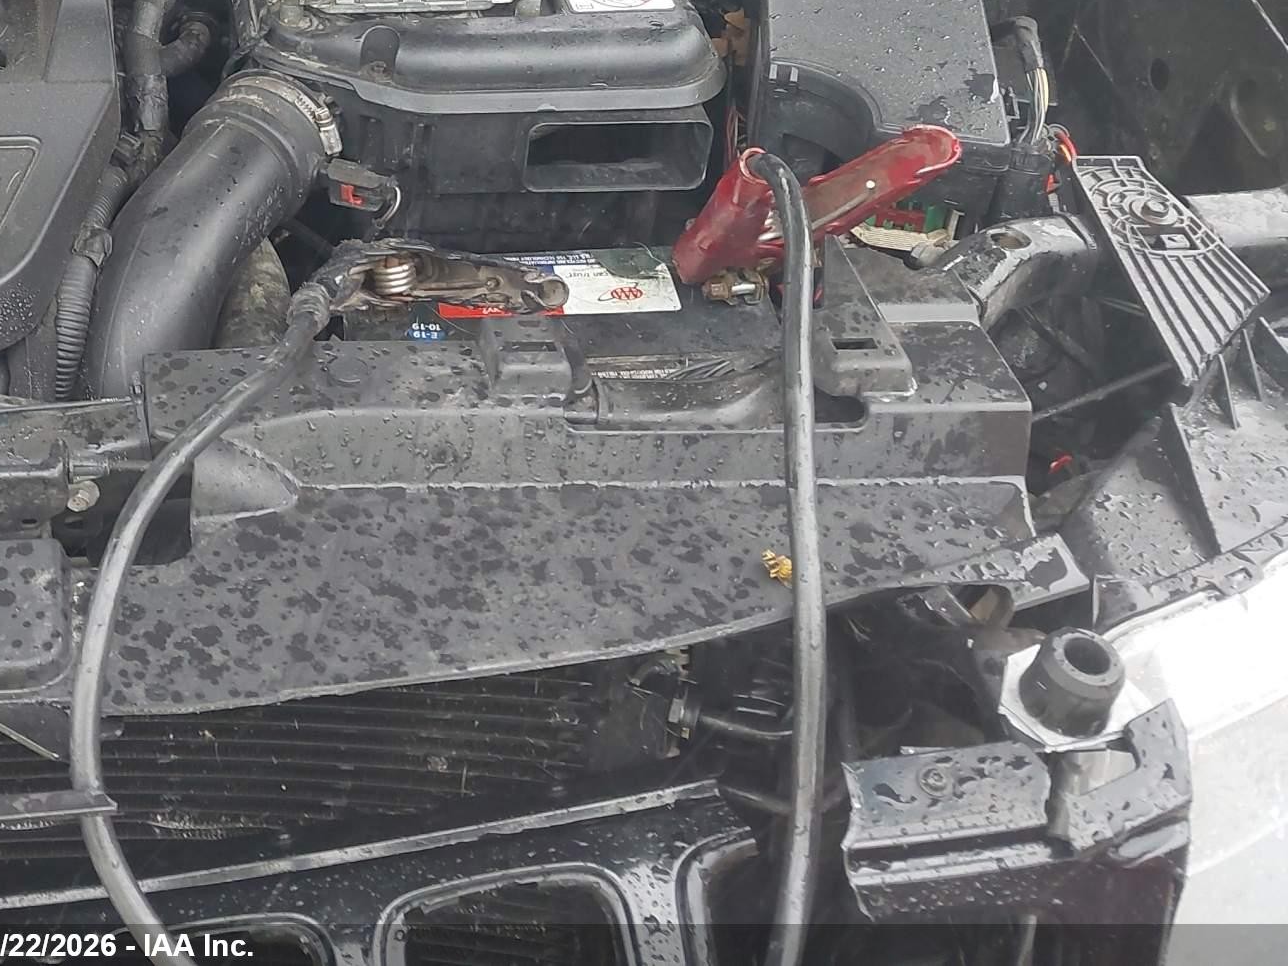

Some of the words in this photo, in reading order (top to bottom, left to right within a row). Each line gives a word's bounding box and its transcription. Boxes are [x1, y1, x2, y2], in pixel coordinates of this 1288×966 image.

[613, 287, 641, 300] AAA
[411, 322, 441, 331] 10-19
[412, 330, 438, 339] E-19
